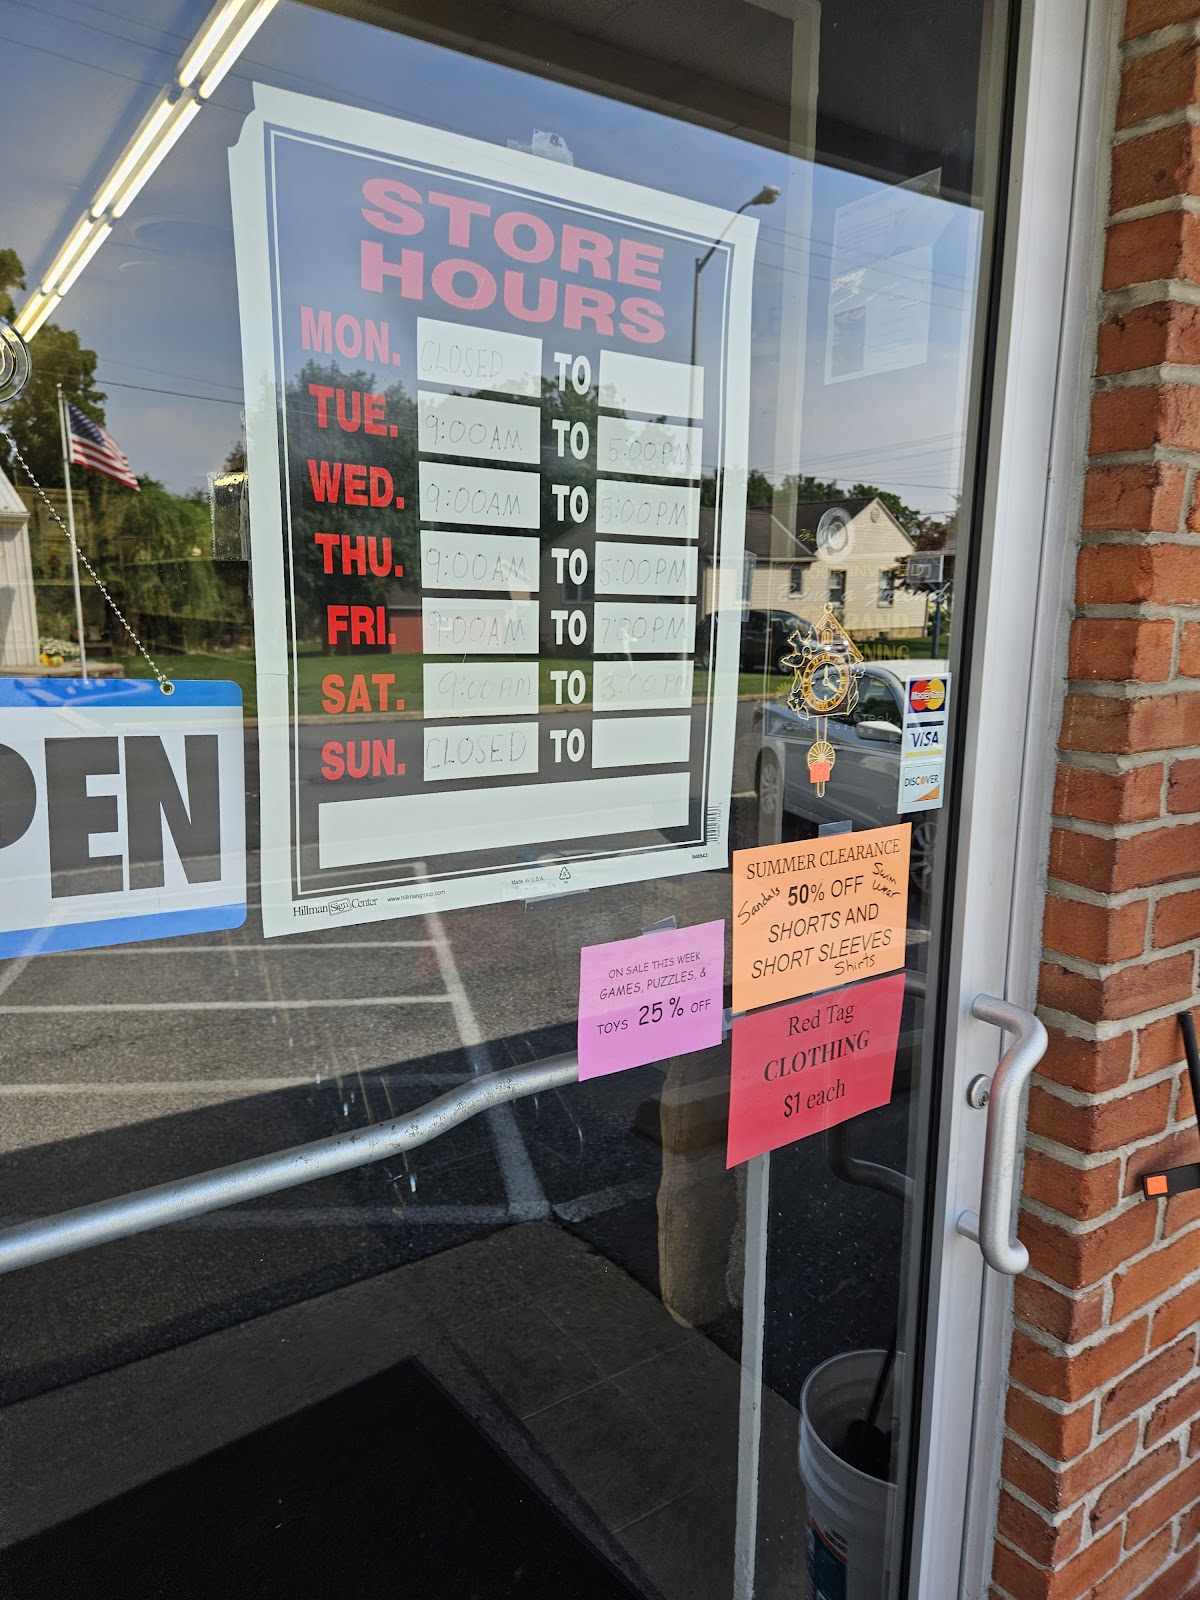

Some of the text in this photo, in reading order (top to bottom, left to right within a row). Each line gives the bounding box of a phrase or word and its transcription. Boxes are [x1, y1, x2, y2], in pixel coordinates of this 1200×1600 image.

[361, 178, 665, 291] STORE
[360, 239, 665, 344] HOURS
[301, 306, 592, 395] MON. CLOSED TO
[308, 384, 399, 438] TUE.
[552, 419, 590, 460] TO
[307, 459, 405, 510] WED.
[552, 484, 589, 523] TO
[314, 533, 404, 577] THU.
[551, 548, 588, 585] TO
[327, 605, 397, 646] FRI.
[551, 609, 587, 646] TO
[321, 673, 405, 714] SAT.
[550, 669, 586, 705] TO
[321, 728, 585, 781] SUN. CLOSED TO
[911, 731, 939, 748] VISA
[904, 774, 939, 787] DISCOVER
[746, 838, 900, 880] SUMMER CLEARANCE
[293, 890, 446, 917] Hillman Sign Center www.hillmangroup.com
[737, 886, 781, 926] Sandals
[787, 875, 864, 907] 50% OFF
[768, 903, 879, 943] SHORTS AND
[608, 951, 701, 979] ON SALE THIS WEEK
[751, 928, 893, 979] SHORT SLEEVES
[834, 953, 876, 976] Shirts
[599, 967, 707, 1001] GAMES, PUZZLES, &
[596, 1019, 629, 1035] TOYS
[690, 999, 711, 1013] OFF
[787, 1004, 855, 1037] Red Tag
[764, 1029, 870, 1082] CLOTHING
[784, 1078, 845, 1118] $1 each
